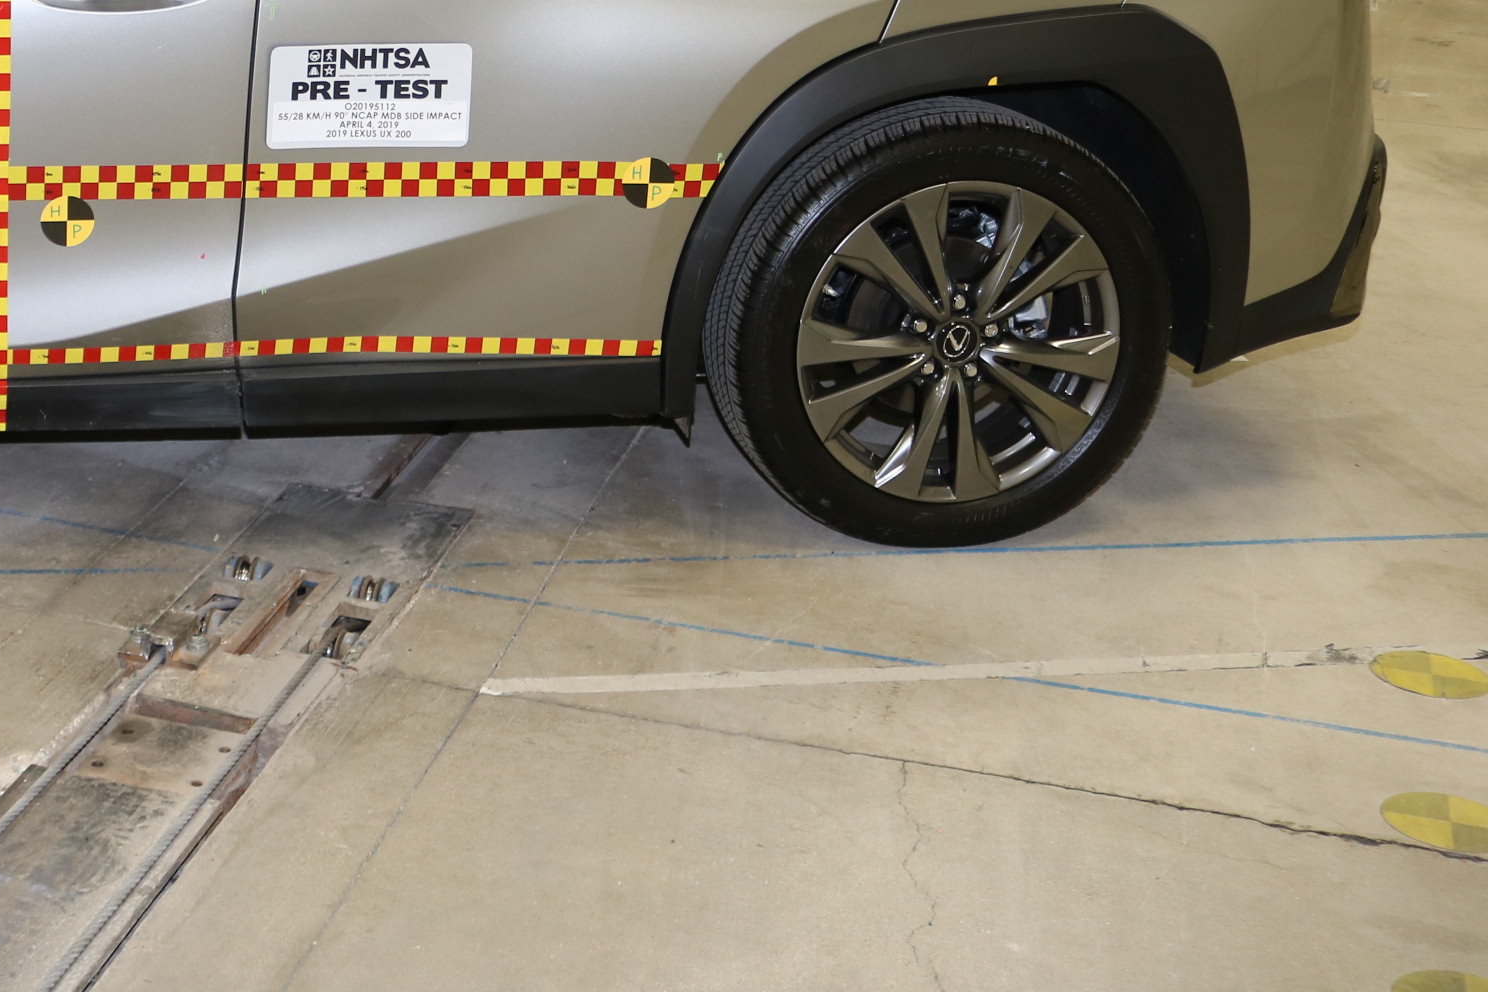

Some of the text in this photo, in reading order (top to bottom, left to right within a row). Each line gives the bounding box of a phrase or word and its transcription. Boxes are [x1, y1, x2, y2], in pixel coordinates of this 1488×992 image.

[339, 47, 430, 70] NHTSA
[291, 80, 350, 101] PRE
[374, 79, 448, 99] TEST
[278, 112, 304, 121] 55/28
[306, 111, 331, 120] KM/H
[351, 111, 378, 120] NCAP
[380, 111, 402, 120] MDB
[404, 112, 424, 120] SIDE
[426, 112, 462, 120] IMPACT
[339, 120, 364, 129] APRIL
[377, 121, 399, 129] 2019
[326, 129, 412, 138] 2019 LEXUS UX 200
[632, 165, 642, 181] H
[651, 185, 662, 201] P
[50, 205, 61, 218] H
[72, 224, 82, 239] P
